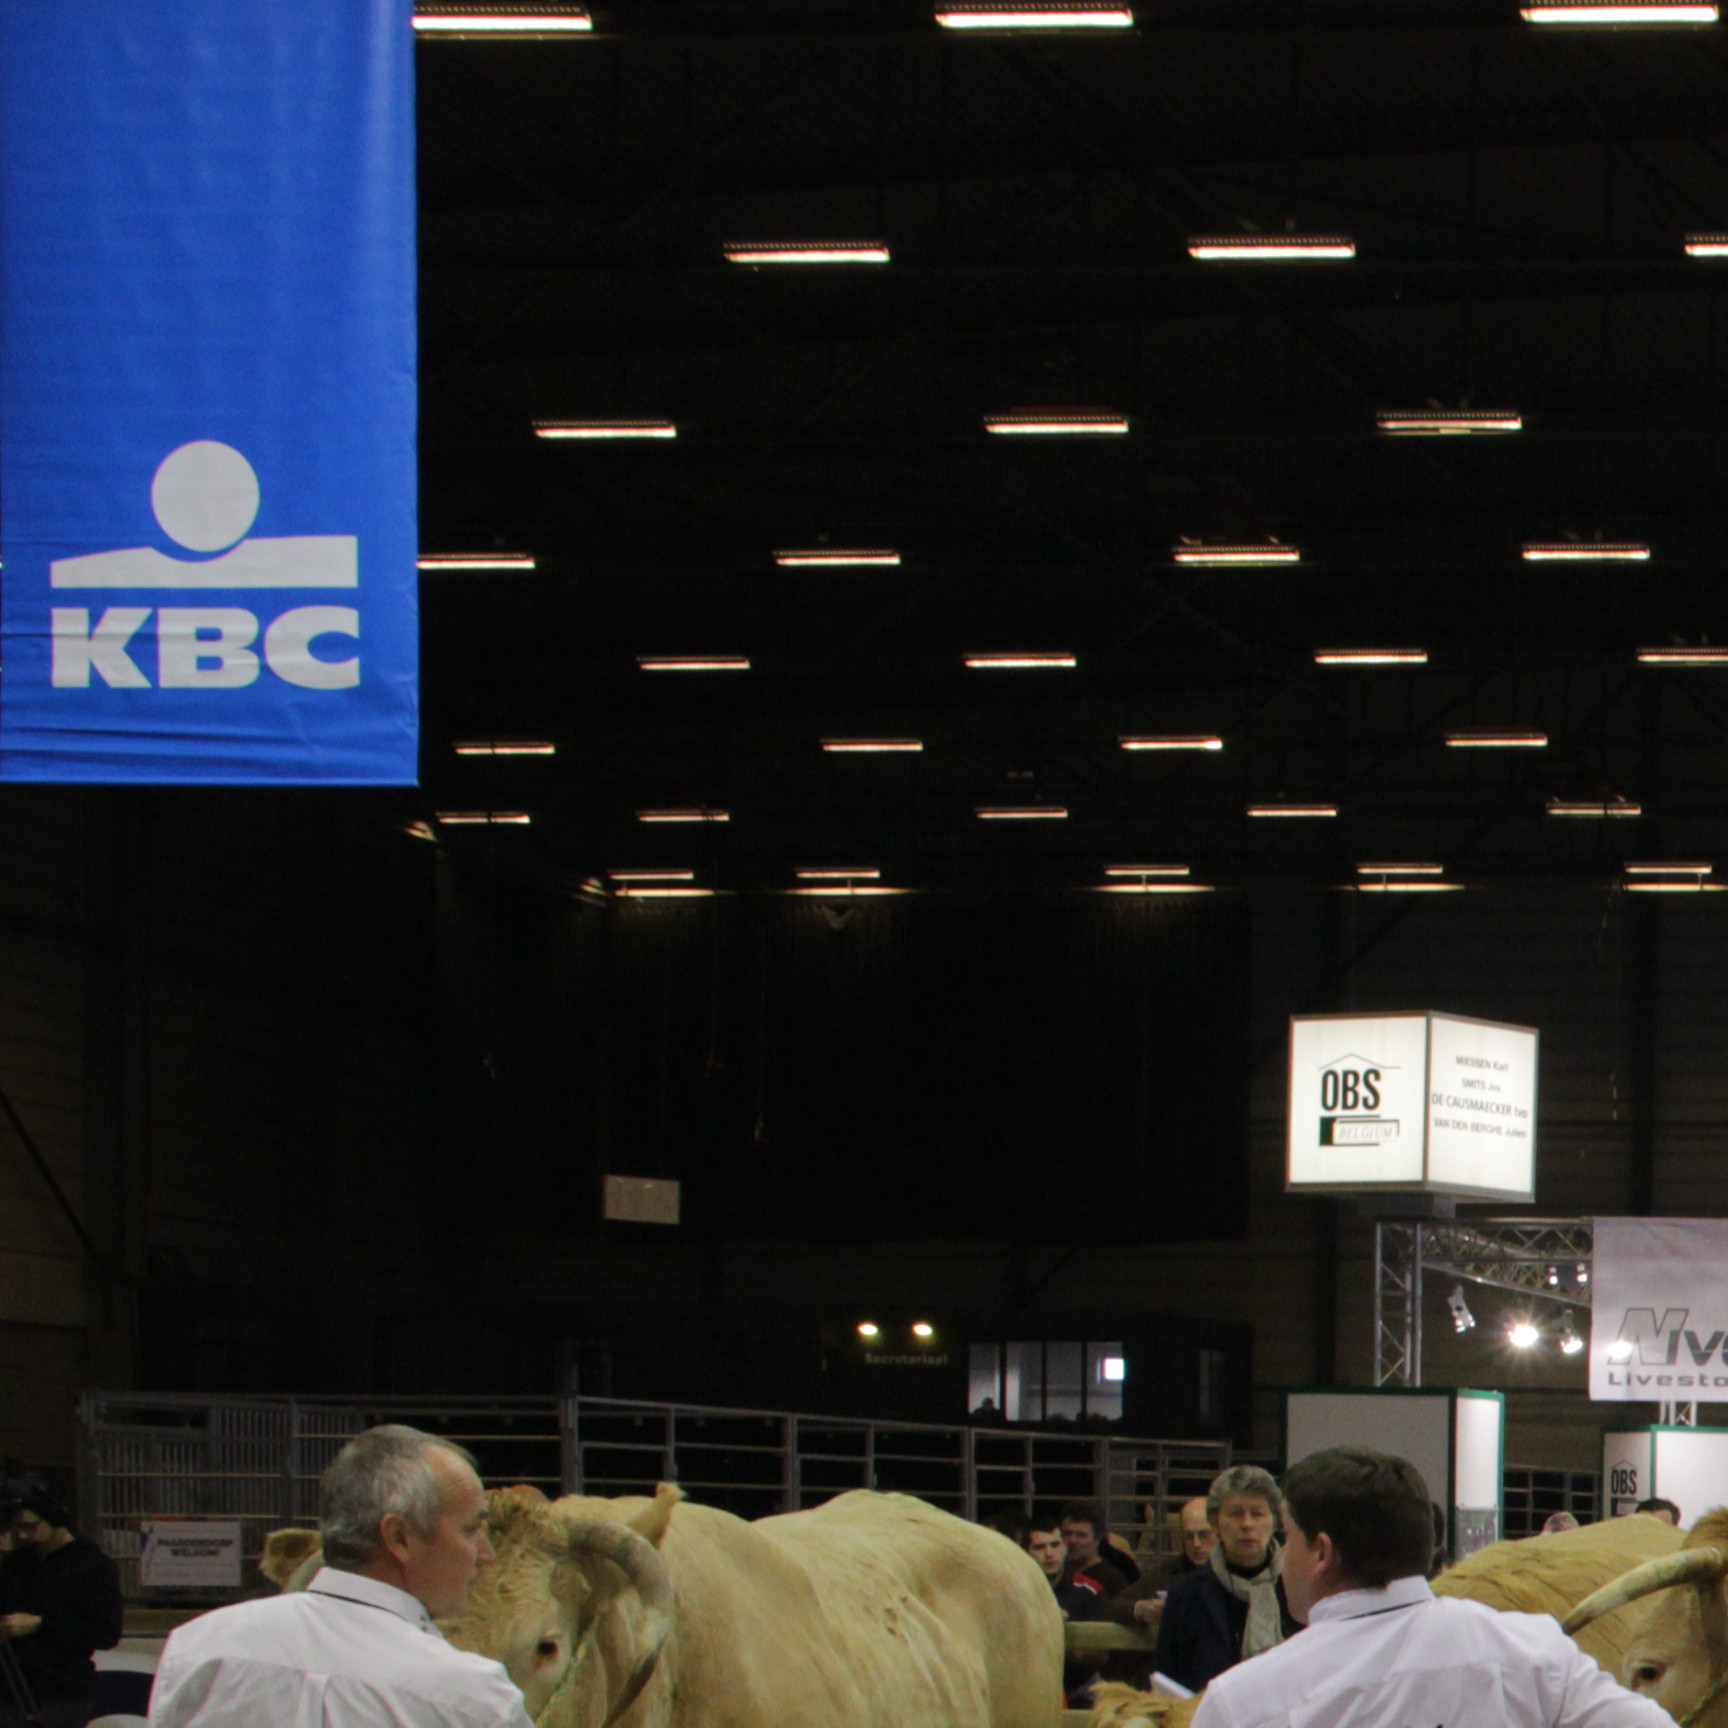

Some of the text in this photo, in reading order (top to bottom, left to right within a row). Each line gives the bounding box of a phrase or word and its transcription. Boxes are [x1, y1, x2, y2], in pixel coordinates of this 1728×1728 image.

[51, 605, 361, 690] KBC
[1321, 1069, 1381, 1111] OBS
[1611, 1470, 1637, 1496] OBS
